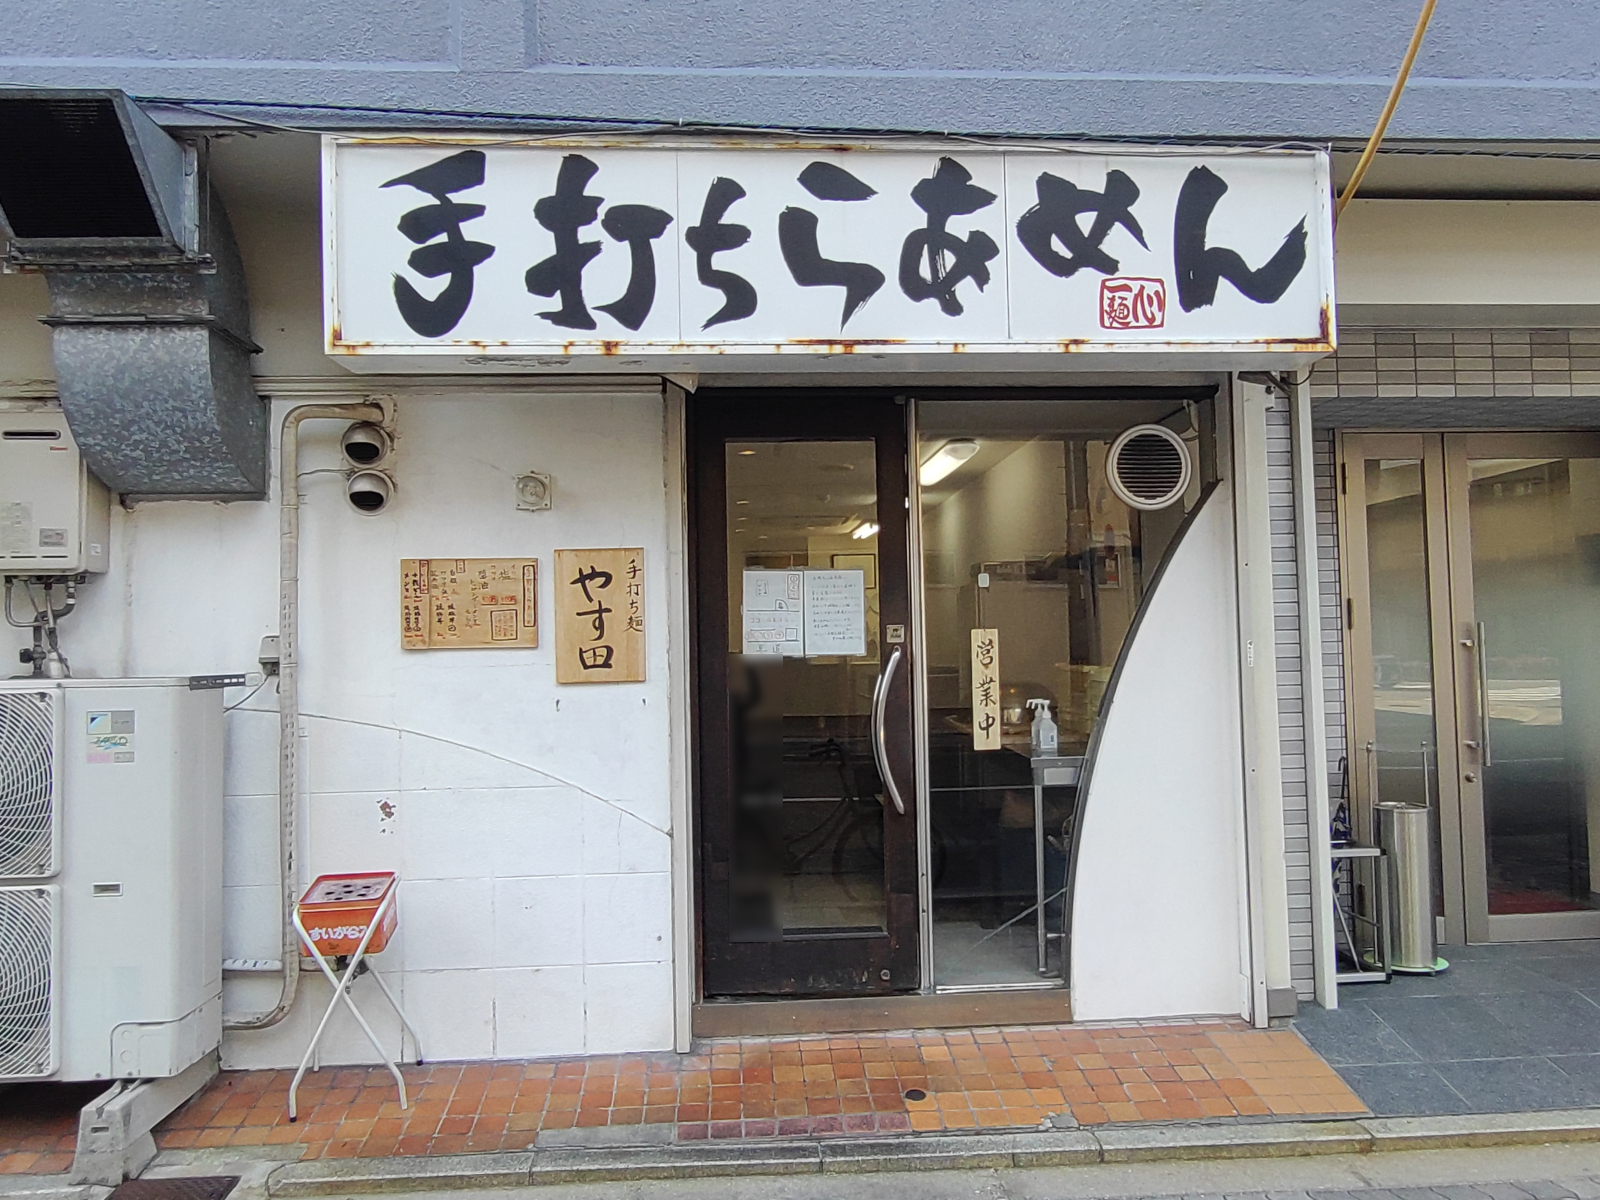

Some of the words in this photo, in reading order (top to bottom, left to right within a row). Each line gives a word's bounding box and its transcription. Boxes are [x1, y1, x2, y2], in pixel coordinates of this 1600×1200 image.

[381, 150, 1307, 337] 手打ちらあめん
[570, 564, 614, 670] やす田
[624, 558, 643, 633] 手打ち麺
[975, 637, 997, 740] 営業中
